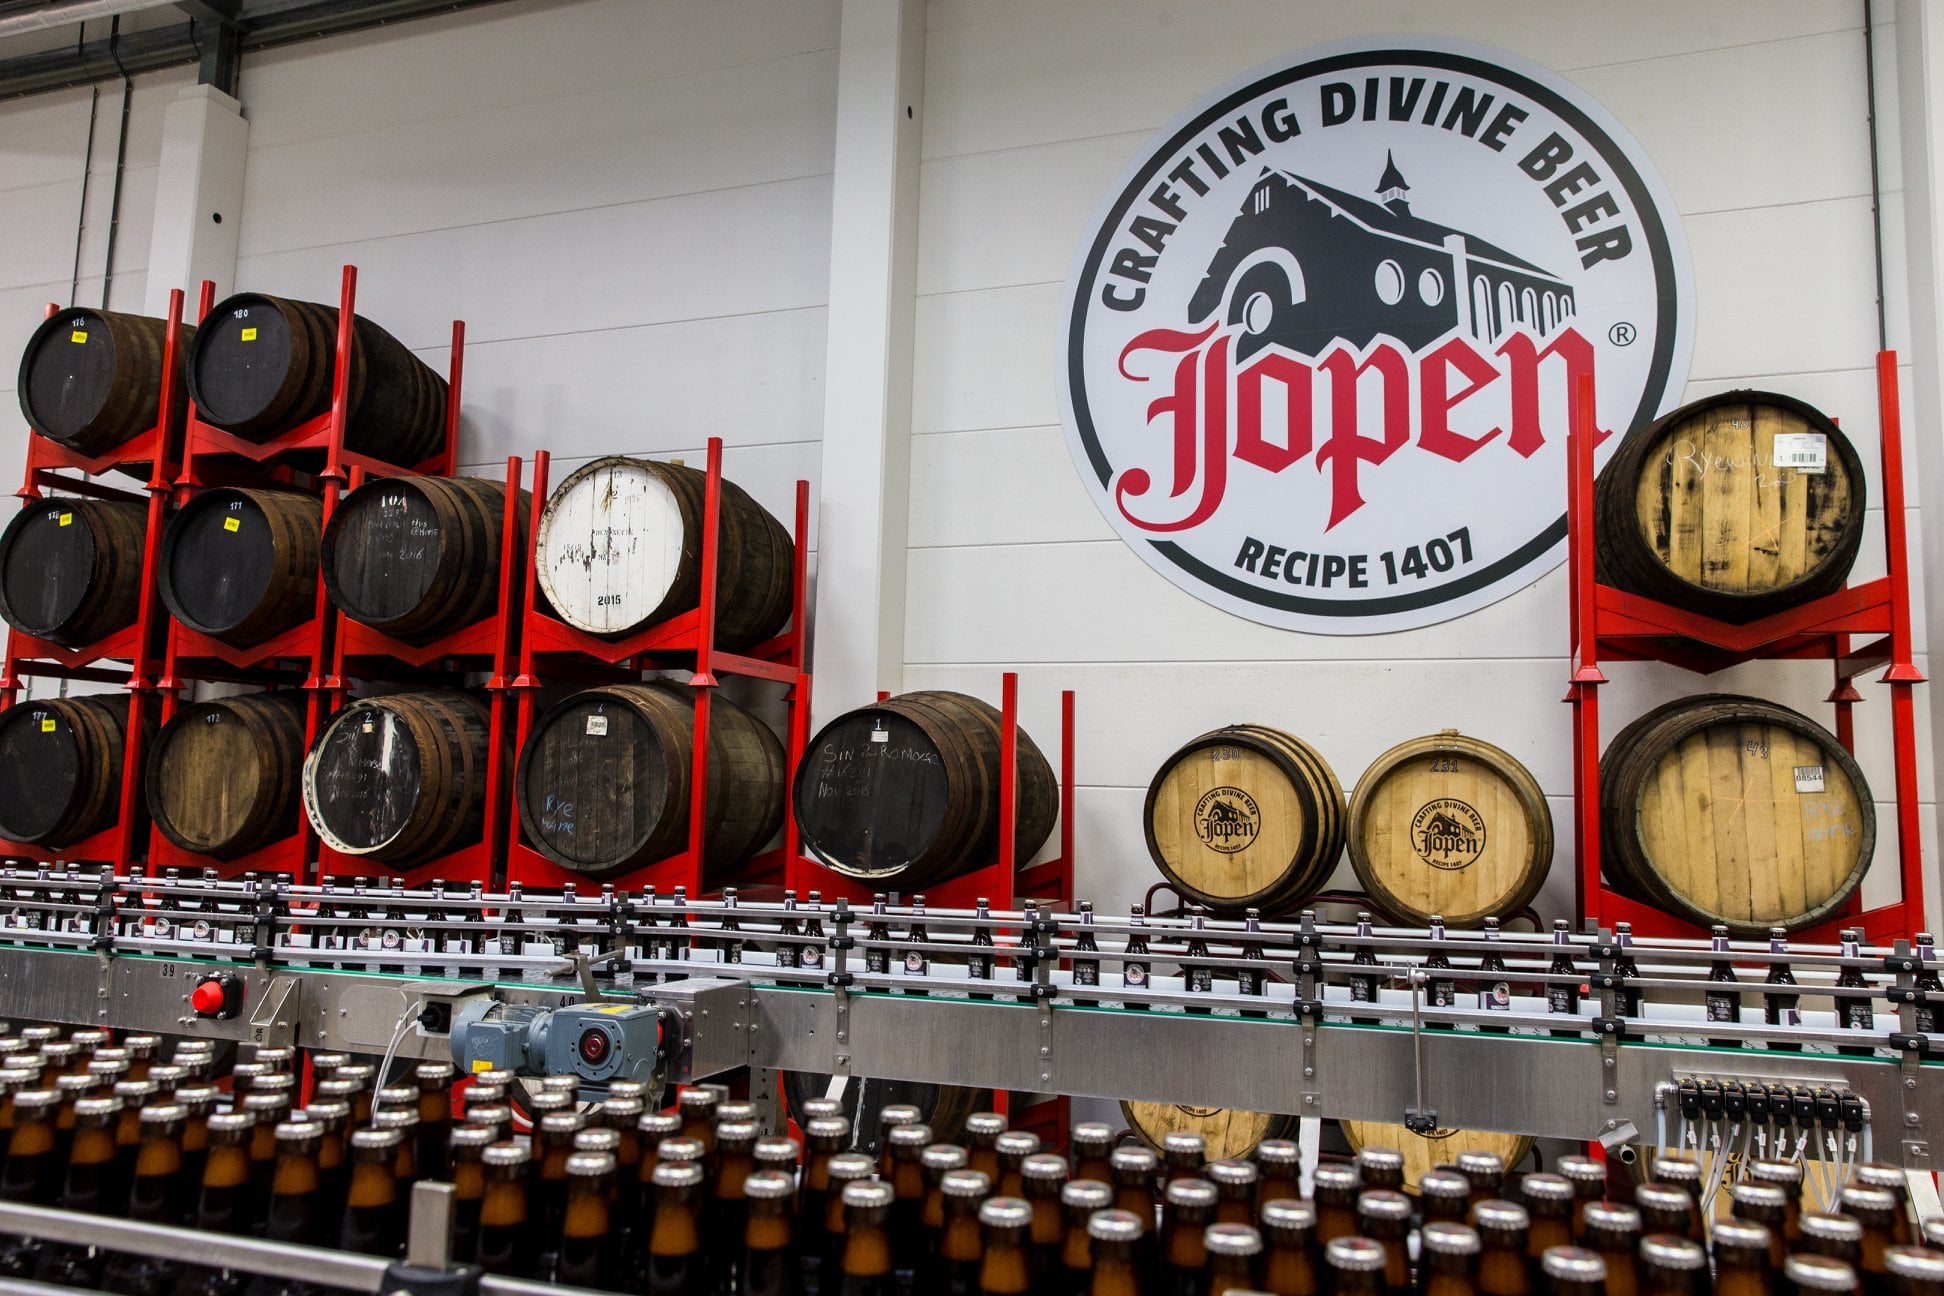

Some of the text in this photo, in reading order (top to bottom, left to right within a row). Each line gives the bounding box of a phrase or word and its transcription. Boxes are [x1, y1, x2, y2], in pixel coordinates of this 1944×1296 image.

[1101, 76, 1633, 312] CRAFTING DIVINE BEER
[233, 309, 249, 319] 180
[72, 317, 85, 327] 176
[1116, 319, 1614, 535] Jopen
[1233, 525, 1474, 589] RECIPE 1407
[597, 594, 621, 606] 2015
[365, 711, 373, 723] 2
[875, 718, 882, 731] 1
[1211, 747, 1240, 762] 230
[1746, 740, 1769, 759] 43
[1429, 759, 1459, 773] 231
[1414, 802, 1442, 828] CRAFTING
[1444, 801, 1470, 814] DIVINE
[1200, 818, 1254, 844] Jopen
[1417, 830, 1478, 859] Jopen
[162, 963, 175, 977] 39
